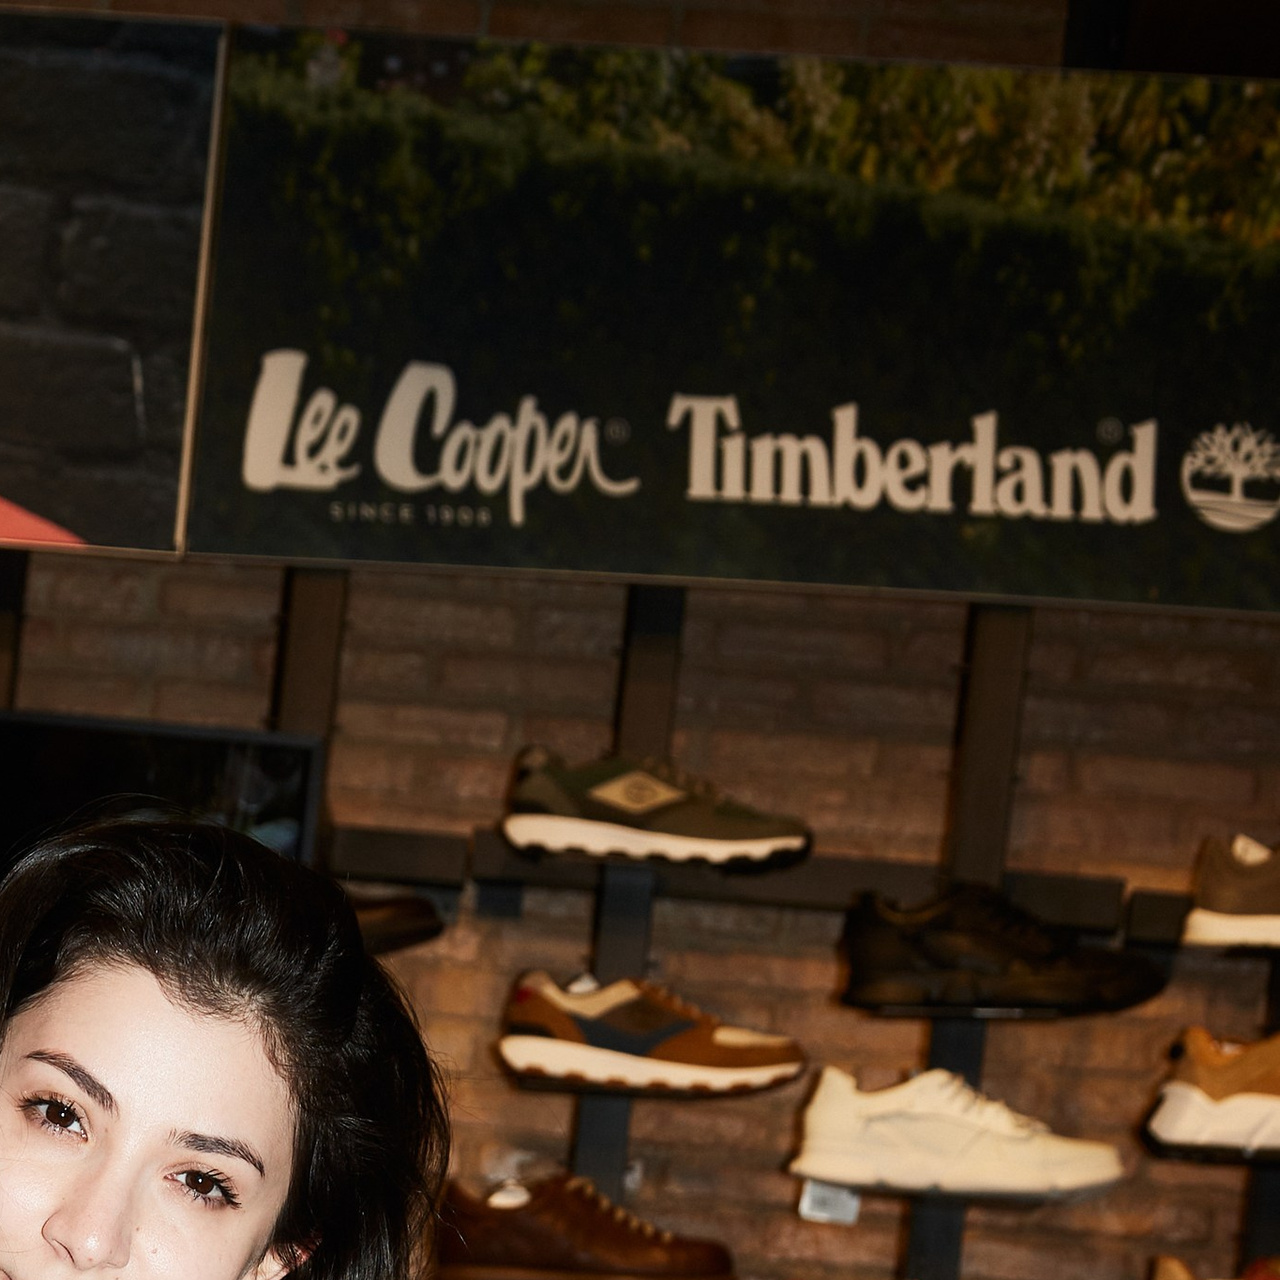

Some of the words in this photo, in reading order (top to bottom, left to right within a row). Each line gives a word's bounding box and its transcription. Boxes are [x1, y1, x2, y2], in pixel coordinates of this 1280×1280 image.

[242, 347, 362, 492] Lee
[374, 358, 640, 528] Cooper
[667, 393, 1157, 524] Timberland
[328, 499, 416, 524] SINCE
